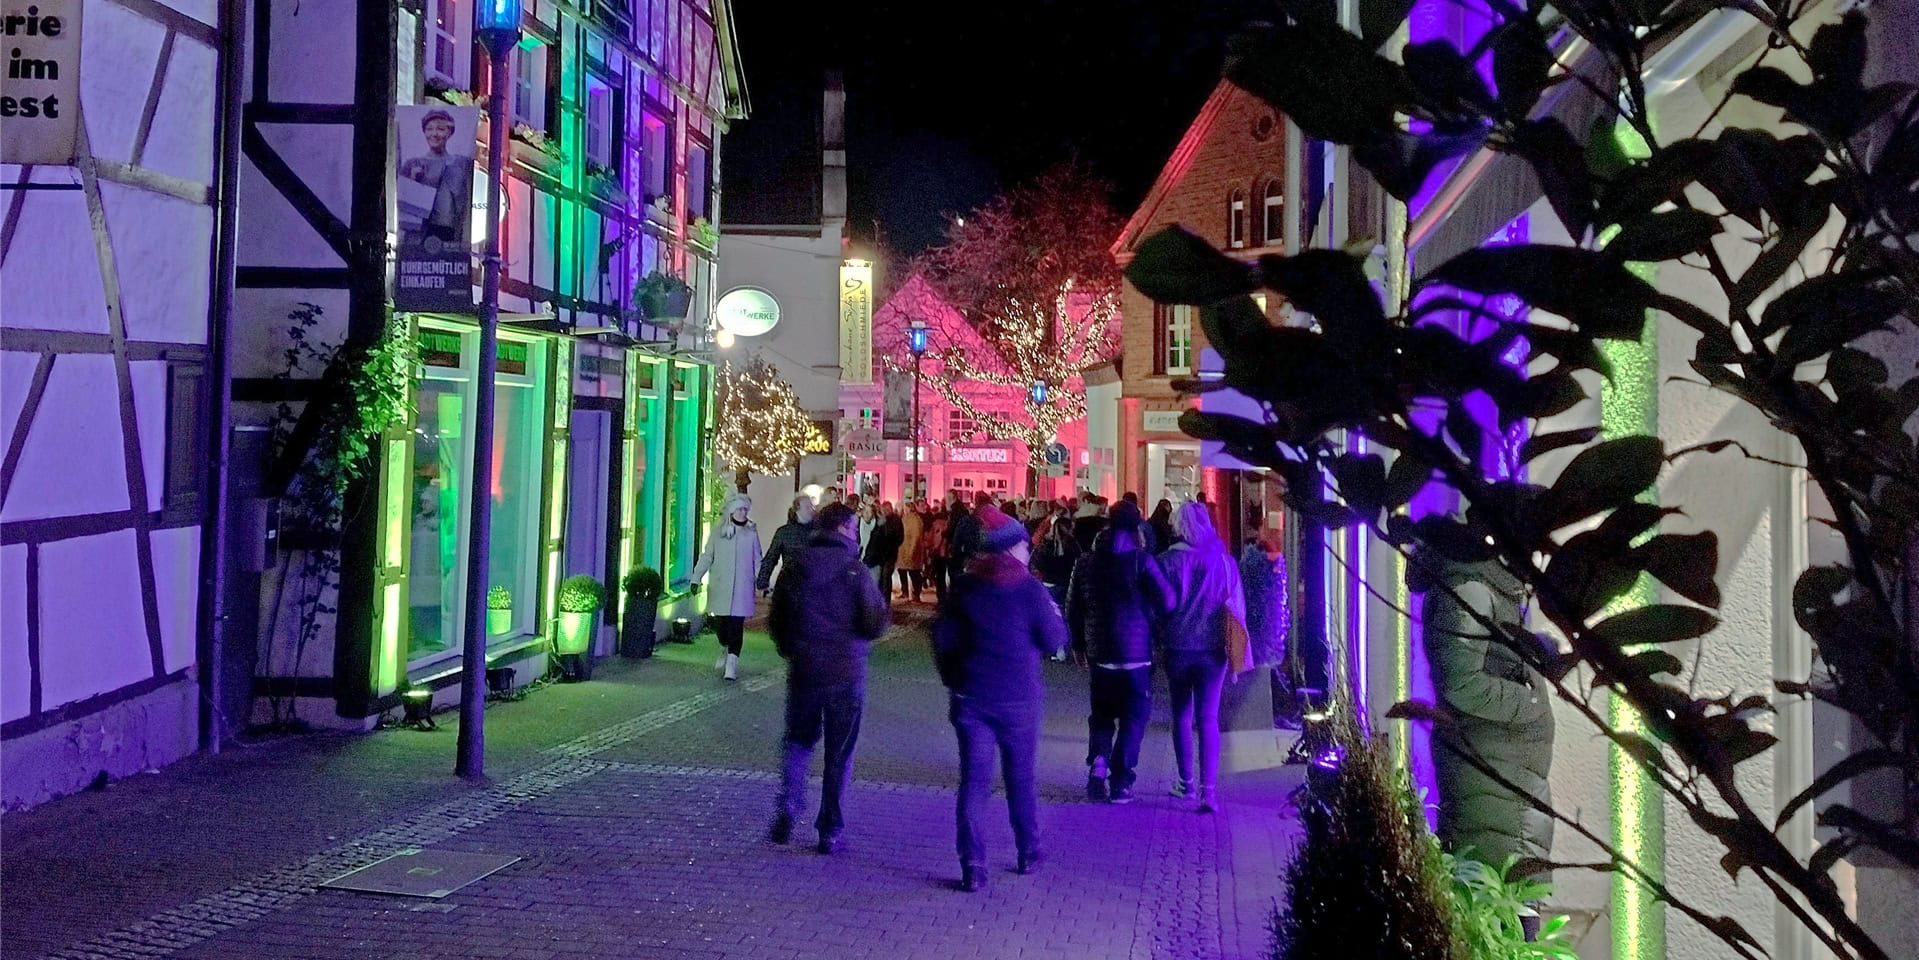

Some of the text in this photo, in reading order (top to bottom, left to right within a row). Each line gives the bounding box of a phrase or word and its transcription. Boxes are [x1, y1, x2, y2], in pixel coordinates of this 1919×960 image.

[0, 5, 61, 36] rie
[8, 48, 59, 80] im
[0, 94, 59, 119] est
[401, 260, 469, 275] RUHRGEMÜTLICH
[401, 275, 445, 288] EINKAUFEN
[849, 442, 882, 451] BASIC
